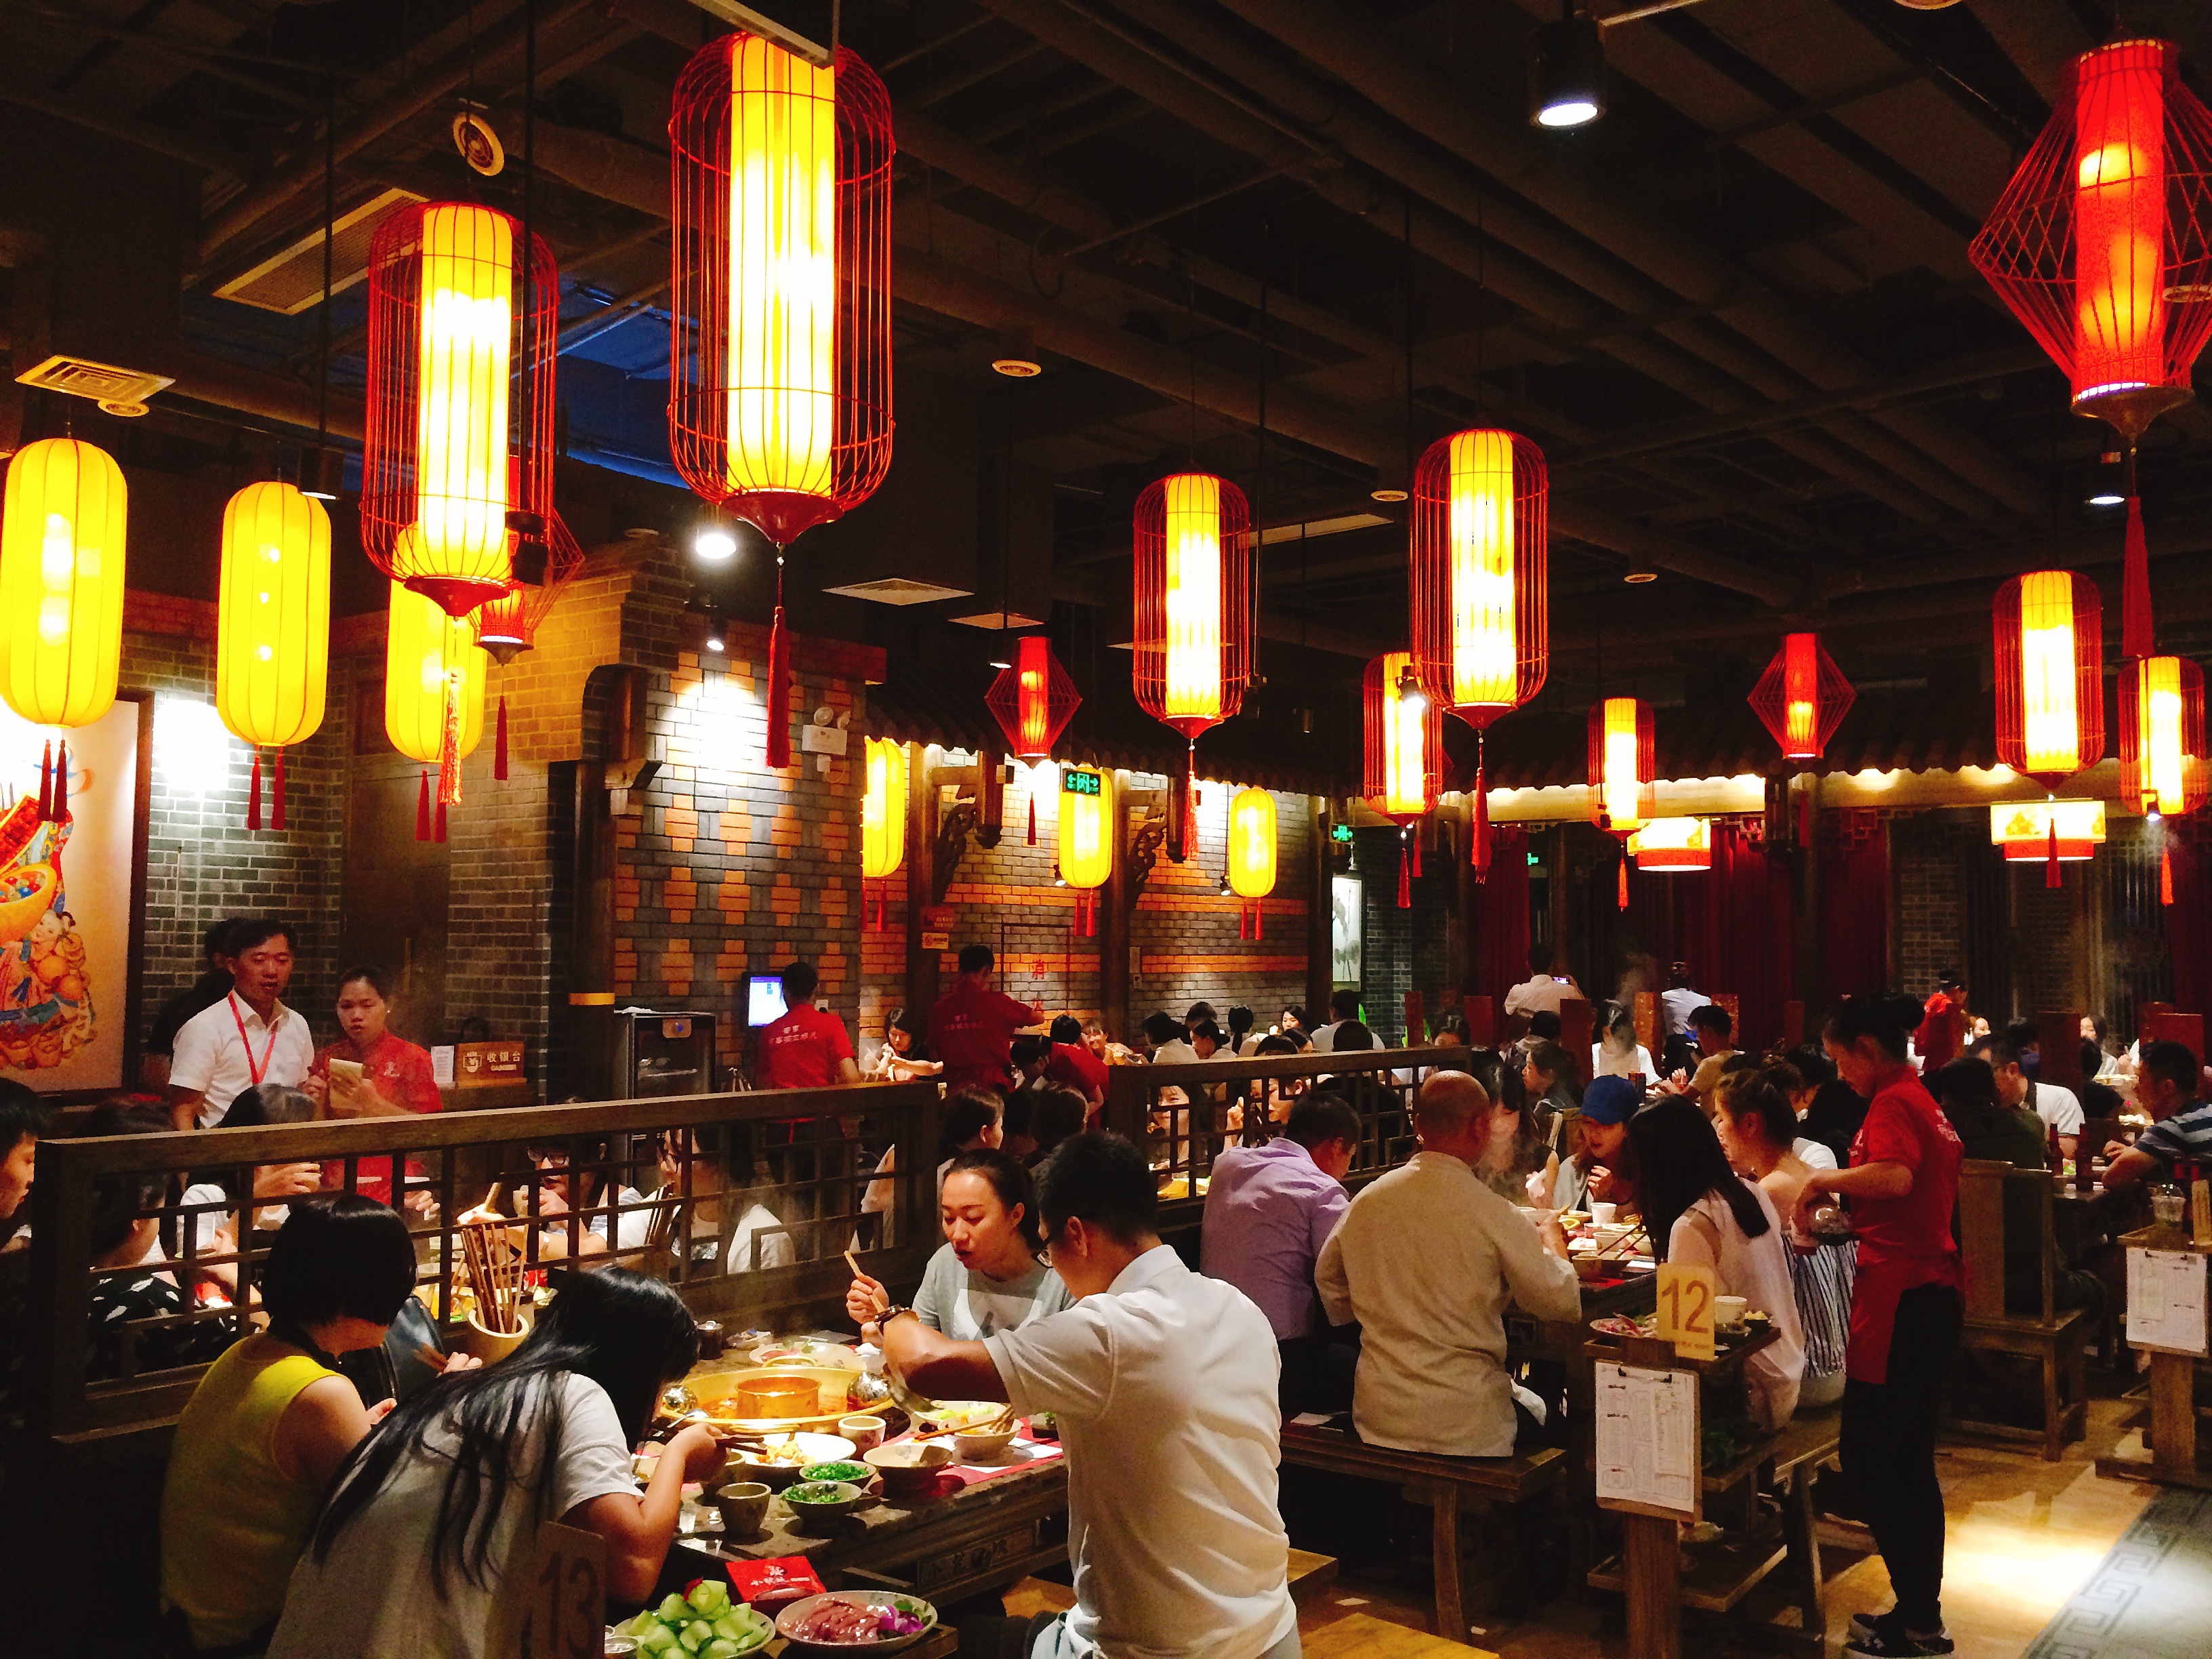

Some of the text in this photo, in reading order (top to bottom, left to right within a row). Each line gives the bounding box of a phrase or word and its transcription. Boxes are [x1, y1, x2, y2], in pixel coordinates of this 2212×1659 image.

[487, 1050, 521, 1063] 收银台
[1662, 1277, 1709, 1334] 12
[538, 1551, 598, 1659] 13
